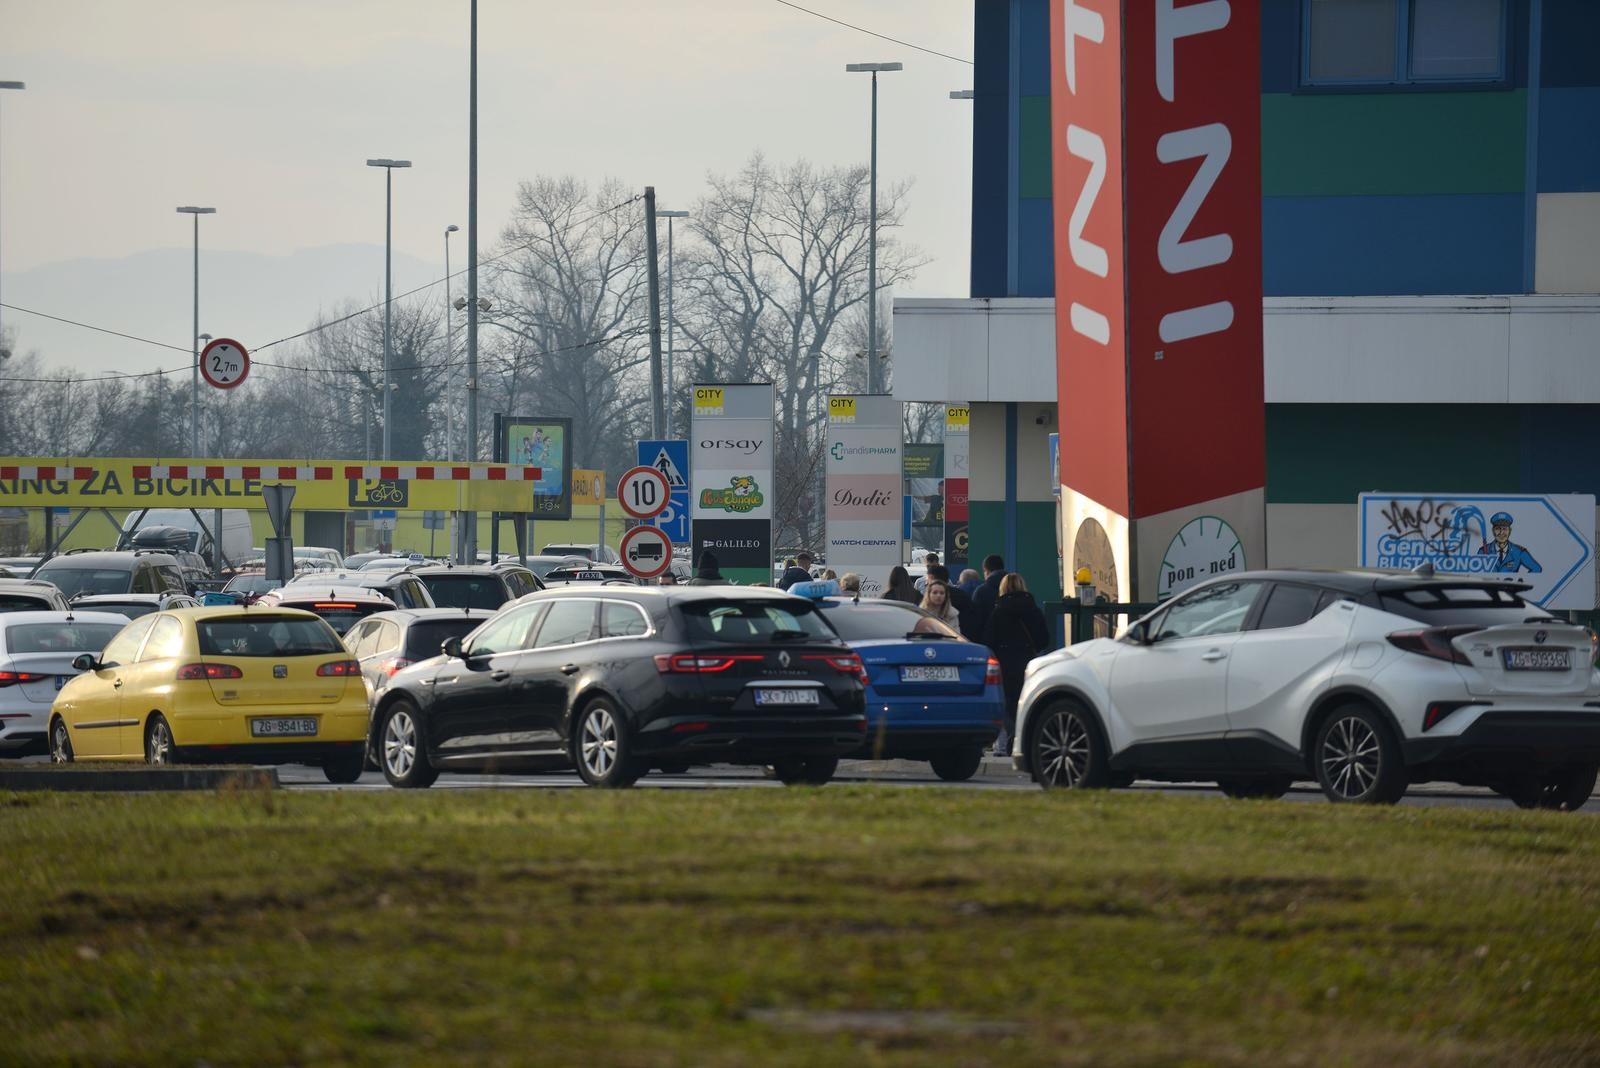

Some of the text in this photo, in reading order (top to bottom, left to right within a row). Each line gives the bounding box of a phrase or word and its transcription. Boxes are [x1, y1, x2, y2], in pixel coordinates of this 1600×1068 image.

[212, 356, 238, 373] 2,7m
[696, 389, 722, 399] CITY
[830, 399, 854, 408] CITY
[695, 407, 724, 416] one
[948, 408, 970, 417] CITY
[829, 415, 856, 424] one
[700, 439, 763, 456] orsay
[840, 445, 896, 455] mandisPHARM
[0, 470, 262, 497] ING ZA BICIKLE
[632, 479, 656, 506] 10
[833, 488, 891, 507] Dodić
[654, 505, 675, 529] P
[715, 540, 761, 548] GALILEO
[1378, 533, 1471, 556] General
[581, 571, 602, 579] TAXI
[1167, 566, 1194, 589] pon
[1210, 552, 1236, 574] ned
[259, 721, 272, 732] ZG
